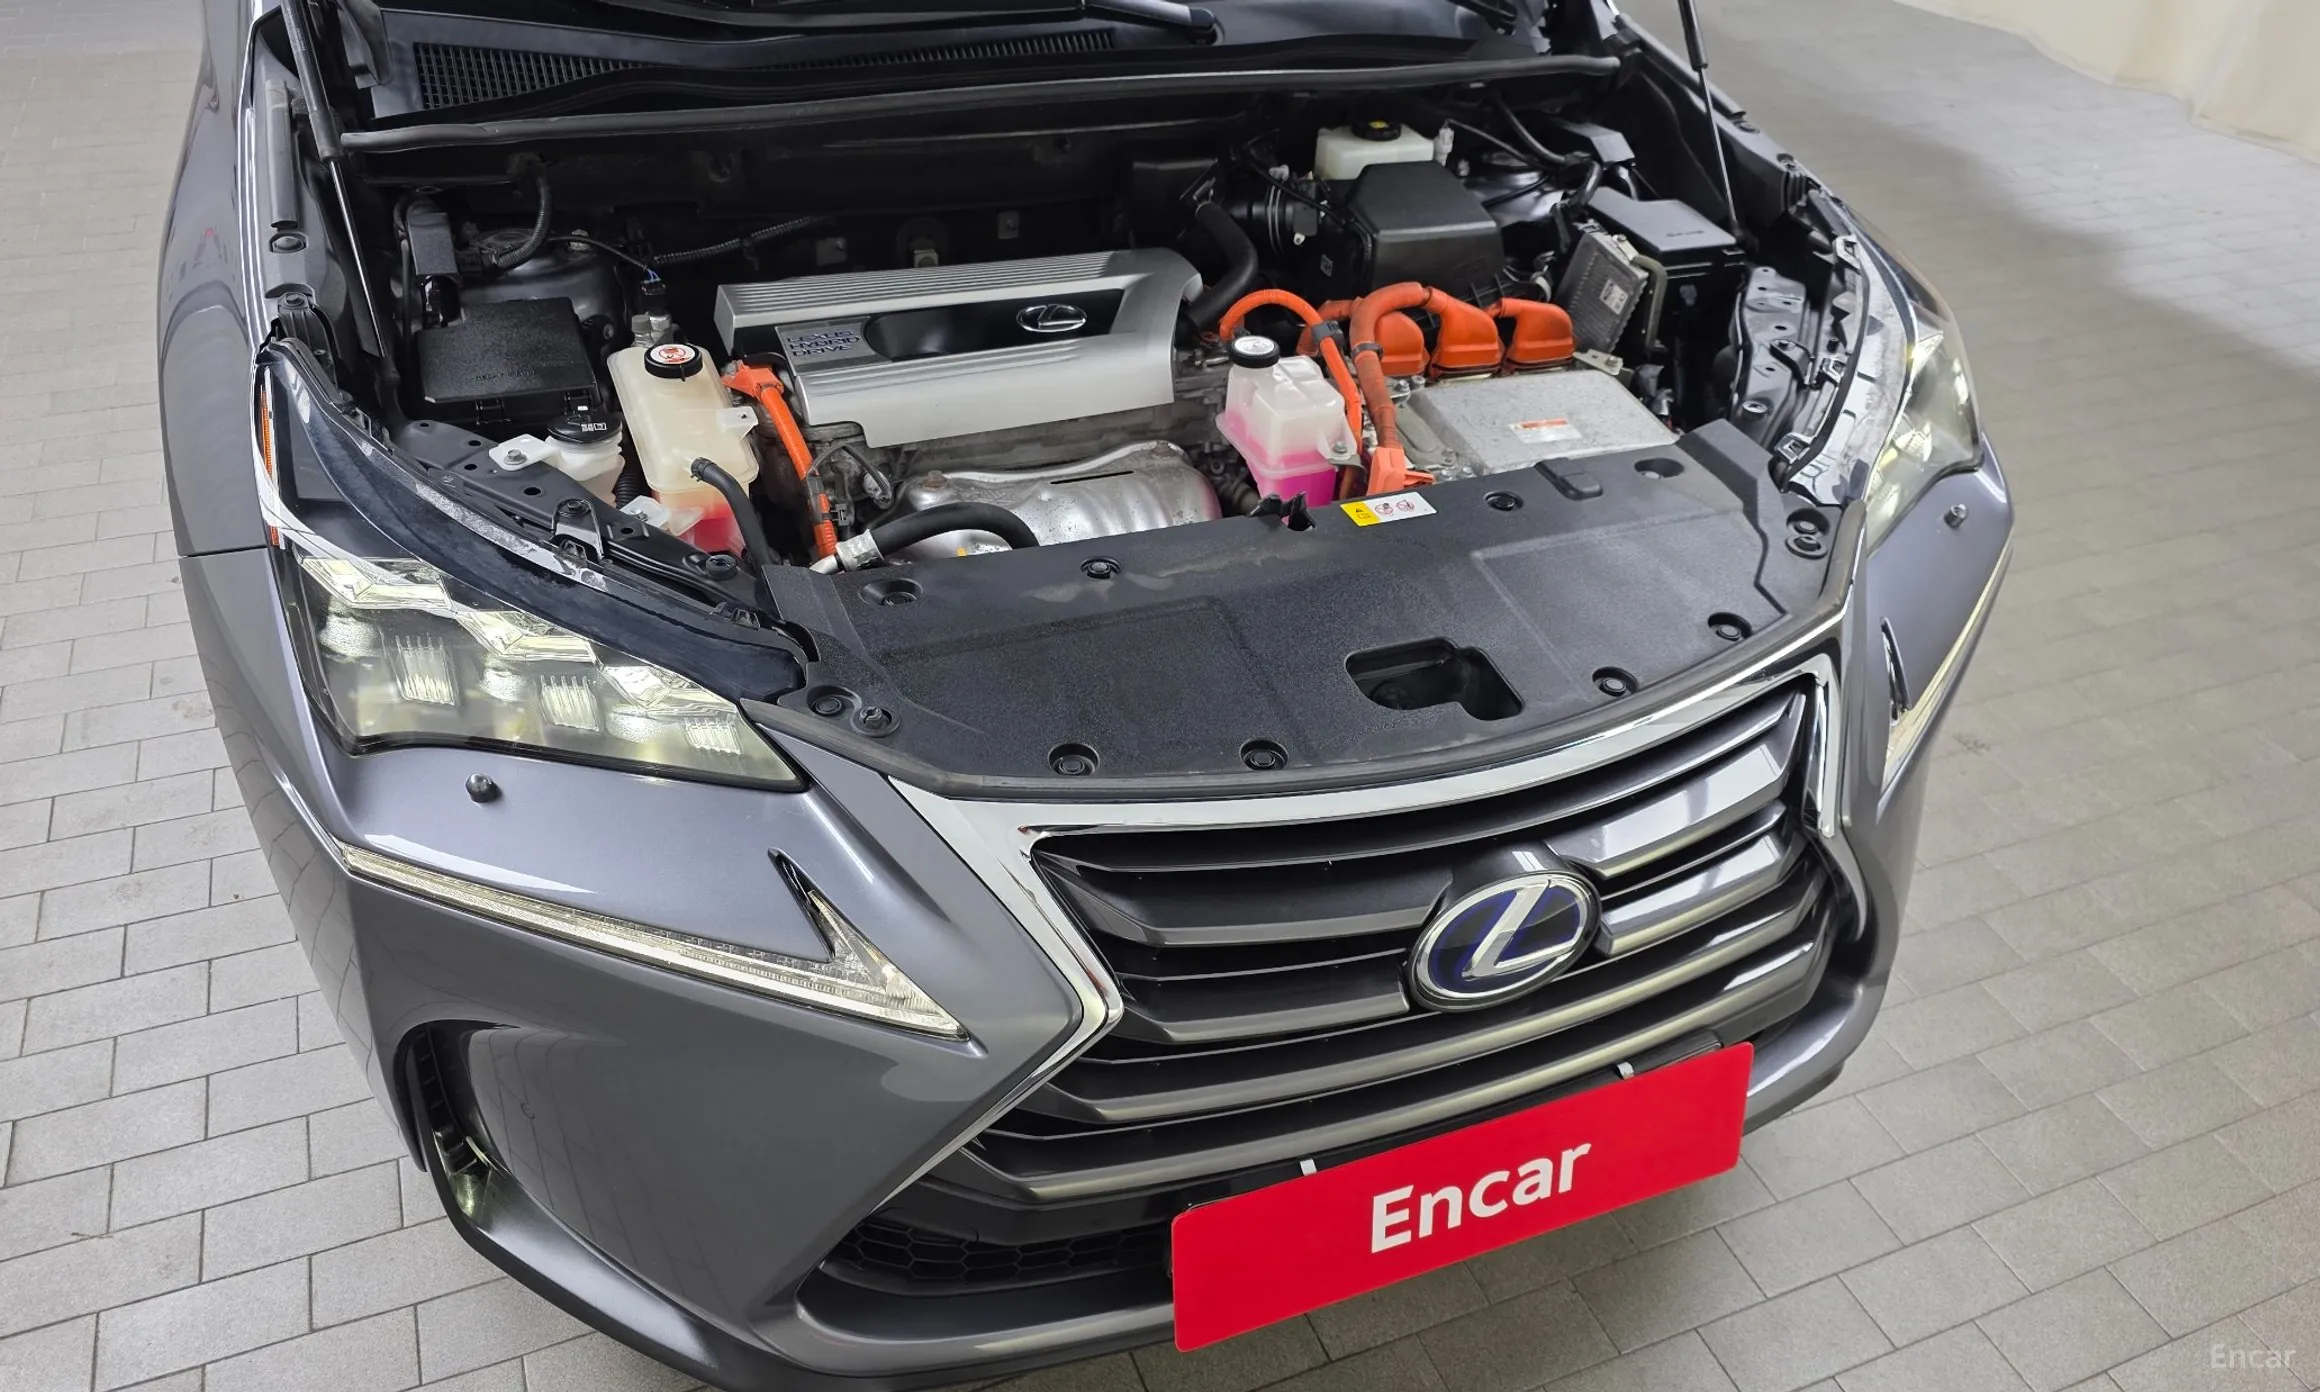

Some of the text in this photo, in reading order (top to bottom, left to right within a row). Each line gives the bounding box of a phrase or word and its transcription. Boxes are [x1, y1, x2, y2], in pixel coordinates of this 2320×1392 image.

[789, 336, 860, 350] HYBRID
[792, 345, 853, 357] DRIVE
[1371, 1143, 1592, 1254] Encar
